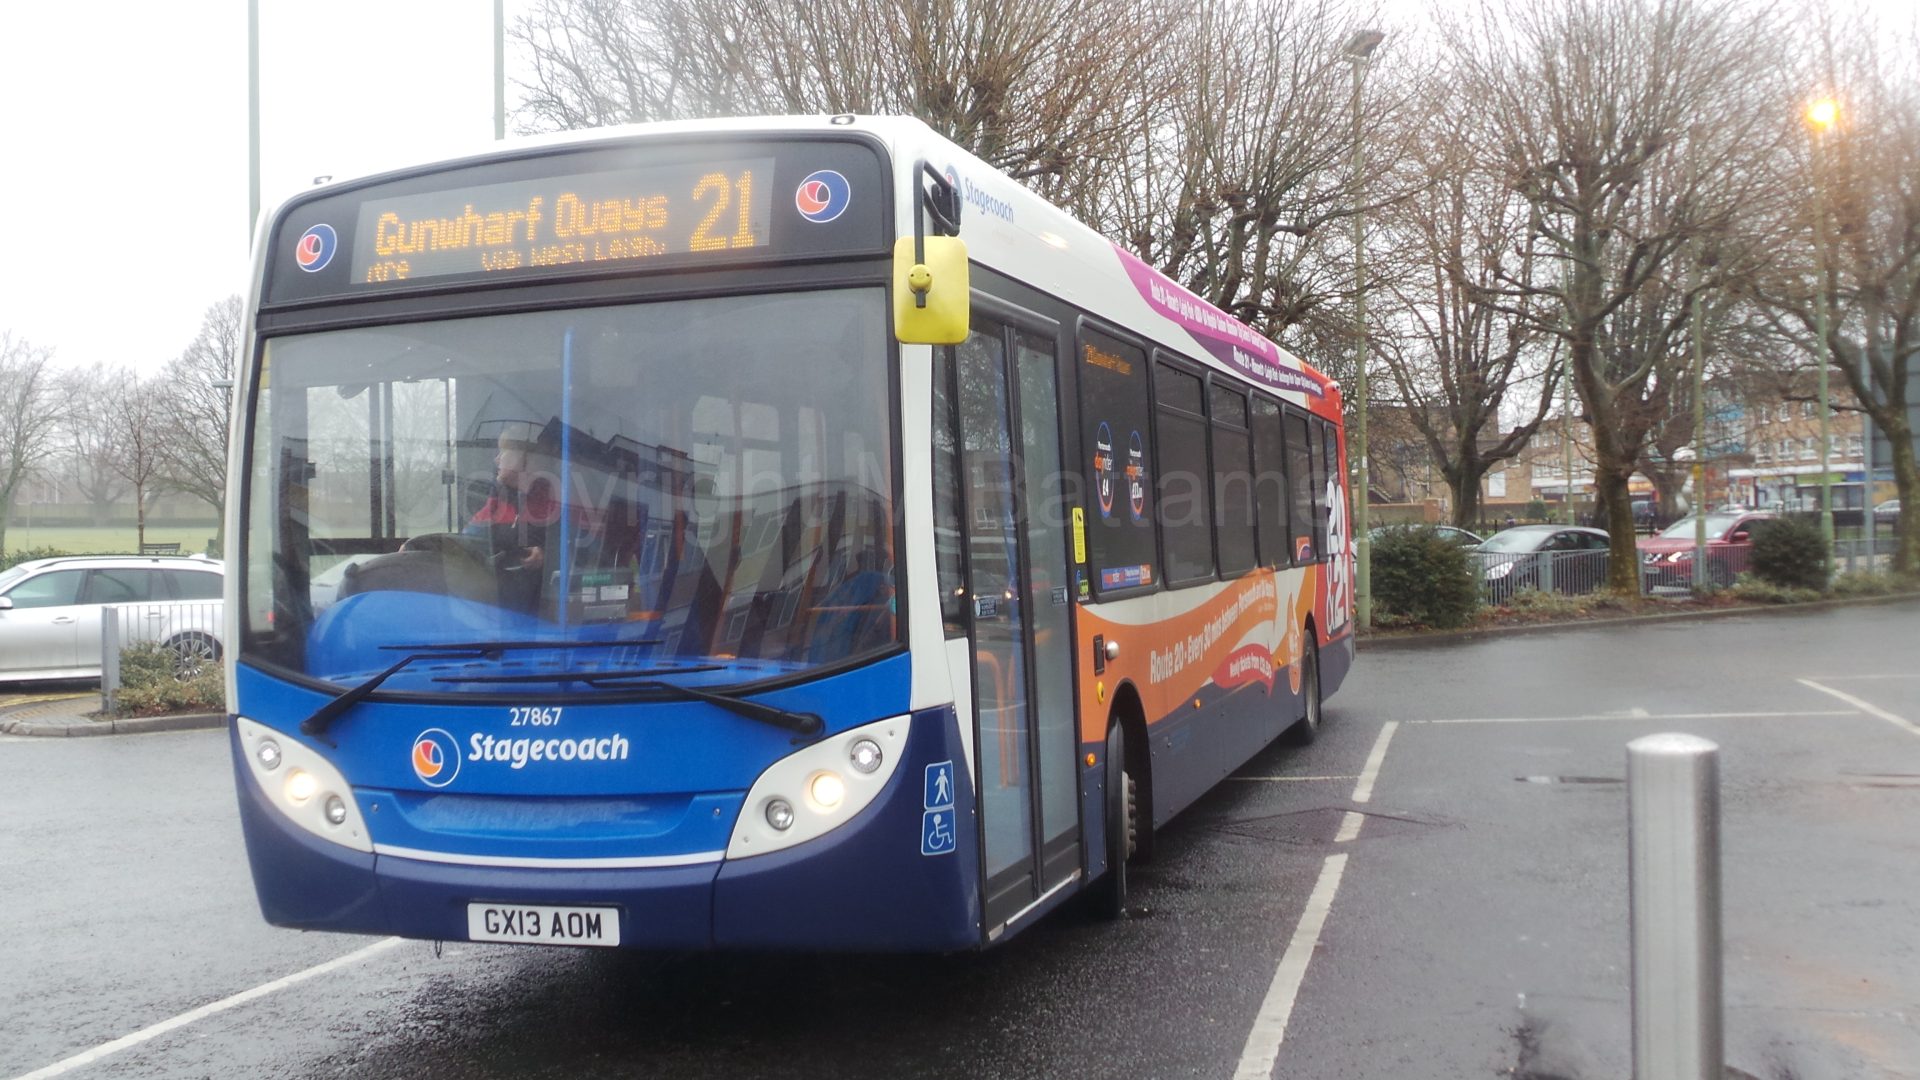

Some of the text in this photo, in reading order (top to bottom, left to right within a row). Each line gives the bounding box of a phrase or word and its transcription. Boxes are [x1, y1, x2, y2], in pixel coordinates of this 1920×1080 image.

[374, 191, 668, 256] Gunwharf Quays
[690, 169, 754, 251] 21
[964, 176, 1014, 224] Stagecoach
[481, 249, 521, 272] via
[530, 242, 585, 268] West
[1326, 479, 1346, 554] 20
[1333, 552, 1349, 630] 21
[1150, 645, 1173, 685] Route
[1174, 640, 1184, 674] 20
[1188, 633, 1204, 662] Every
[509, 706, 563, 727] 27867
[468, 732, 630, 770] Stagecoach
[484, 908, 602, 939] GX13 AOM
